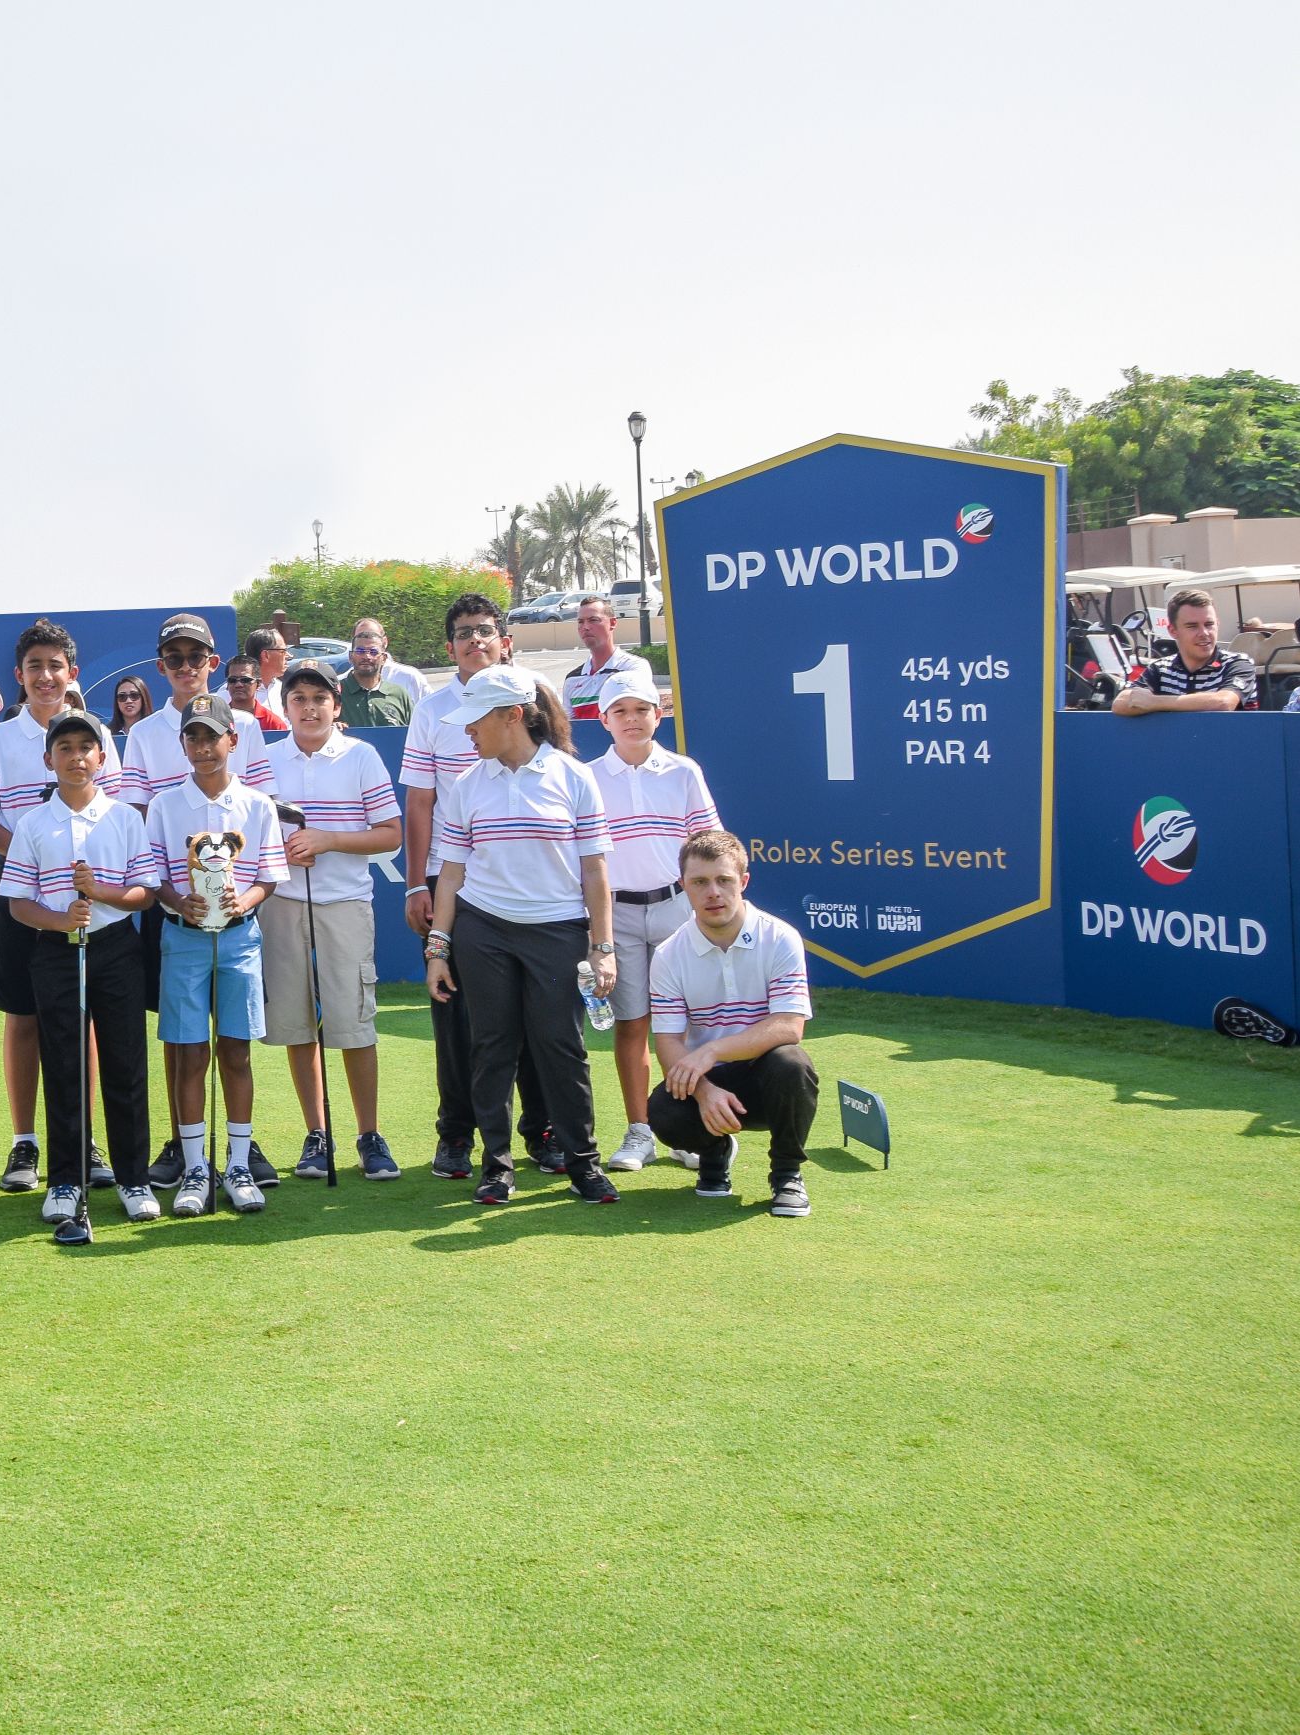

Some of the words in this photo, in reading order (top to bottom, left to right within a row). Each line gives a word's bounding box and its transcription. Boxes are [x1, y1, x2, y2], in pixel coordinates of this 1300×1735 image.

[706, 551, 766, 592] DP
[774, 538, 958, 587] WORLD
[901, 657, 951, 681] 454
[958, 655, 1009, 686] yds
[793, 644, 854, 780] 1
[903, 698, 953, 723] 415
[961, 702, 987, 722] m
[905, 740, 966, 764] PAR
[973, 740, 991, 764] 4
[750, 838, 822, 864] Rolex
[830, 840, 914, 867] Series
[924, 842, 1007, 869] Event
[809, 902, 857, 912] EUROPEAN
[885, 905, 902, 913] RACE
[903, 906, 912, 914] TO
[805, 911, 859, 929] TOUR
[877, 914, 922, 932] DUBAI
[1081, 901, 1124, 938] DP
[1129, 906, 1267, 956] WORLD
